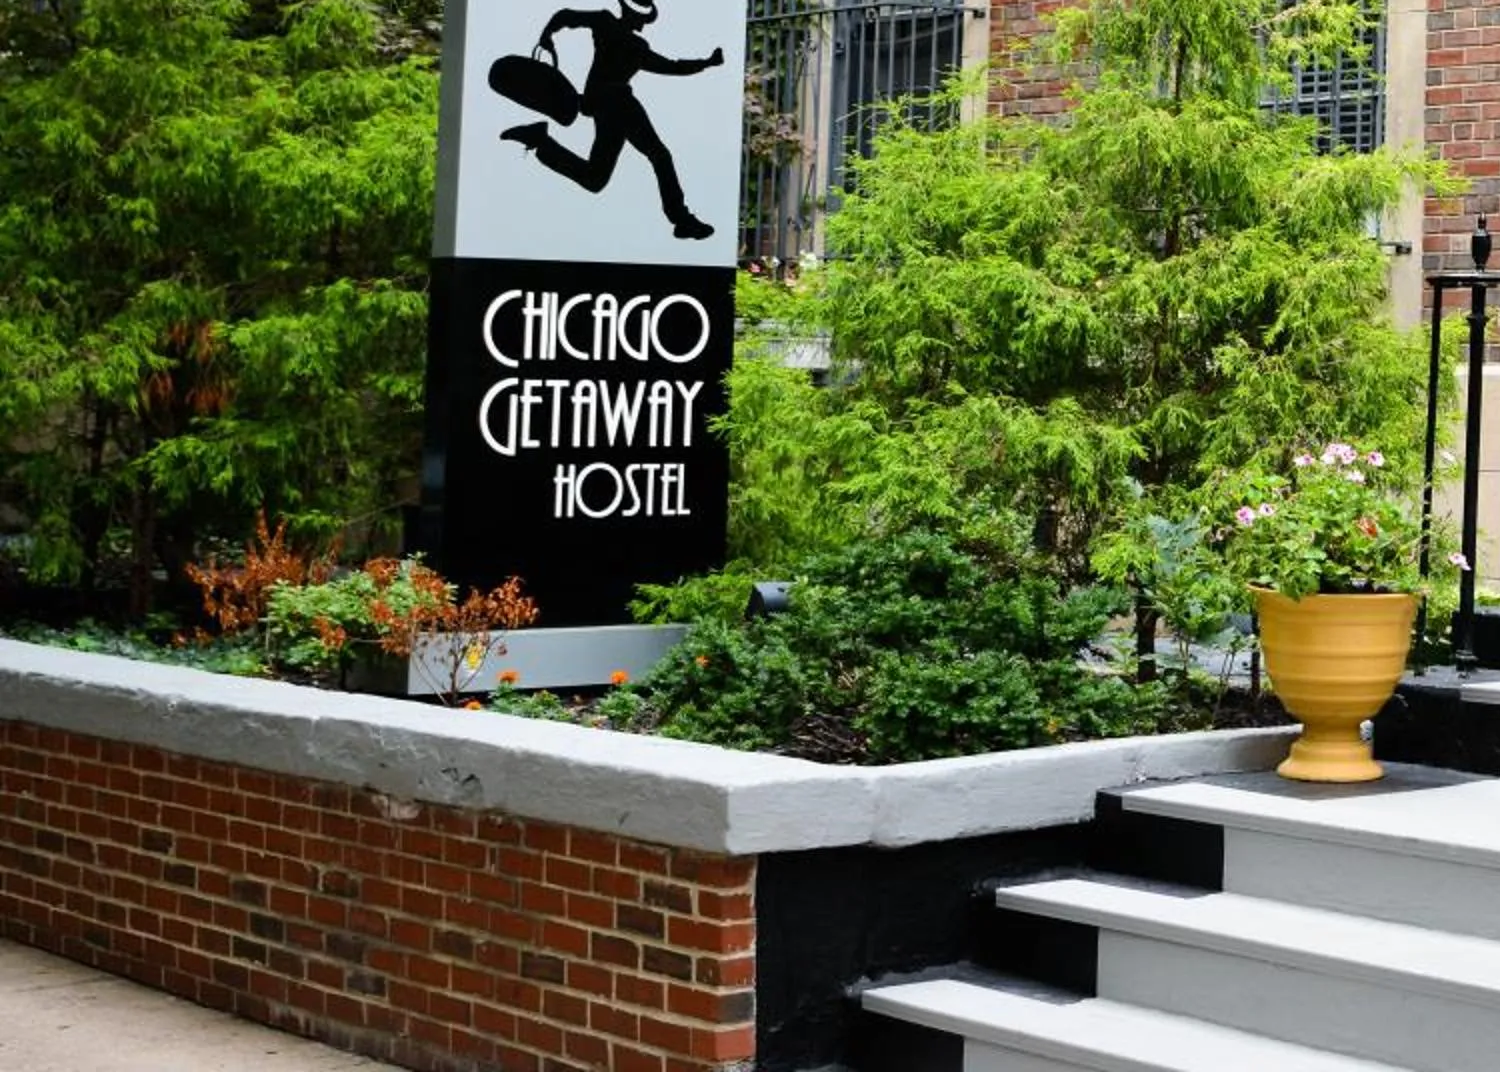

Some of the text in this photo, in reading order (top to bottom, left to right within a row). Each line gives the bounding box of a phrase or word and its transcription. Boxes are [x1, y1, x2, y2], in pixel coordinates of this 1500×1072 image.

[483, 289, 711, 368] CHICAGO
[479, 377, 705, 457] GETAWAY
[553, 462, 692, 519] HOSTEL
